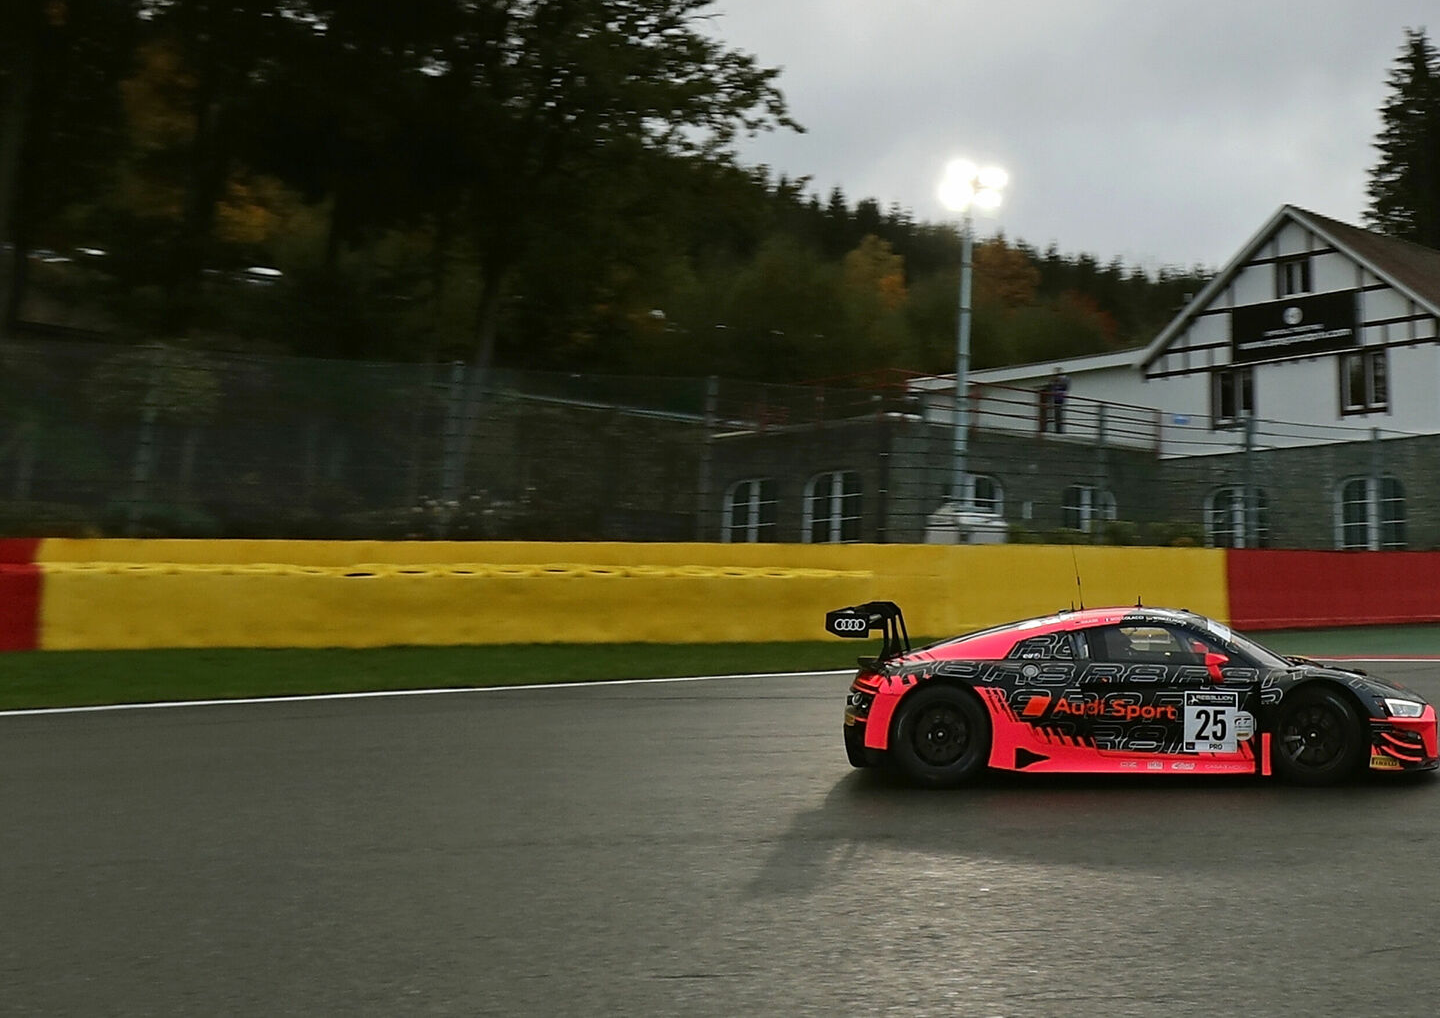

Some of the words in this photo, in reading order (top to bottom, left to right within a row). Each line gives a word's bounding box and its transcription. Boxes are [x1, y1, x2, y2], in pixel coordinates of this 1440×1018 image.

[1053, 697, 1105, 715] Audi
[1111, 699, 1177, 720] Sport
[1195, 709, 1227, 741] 25
